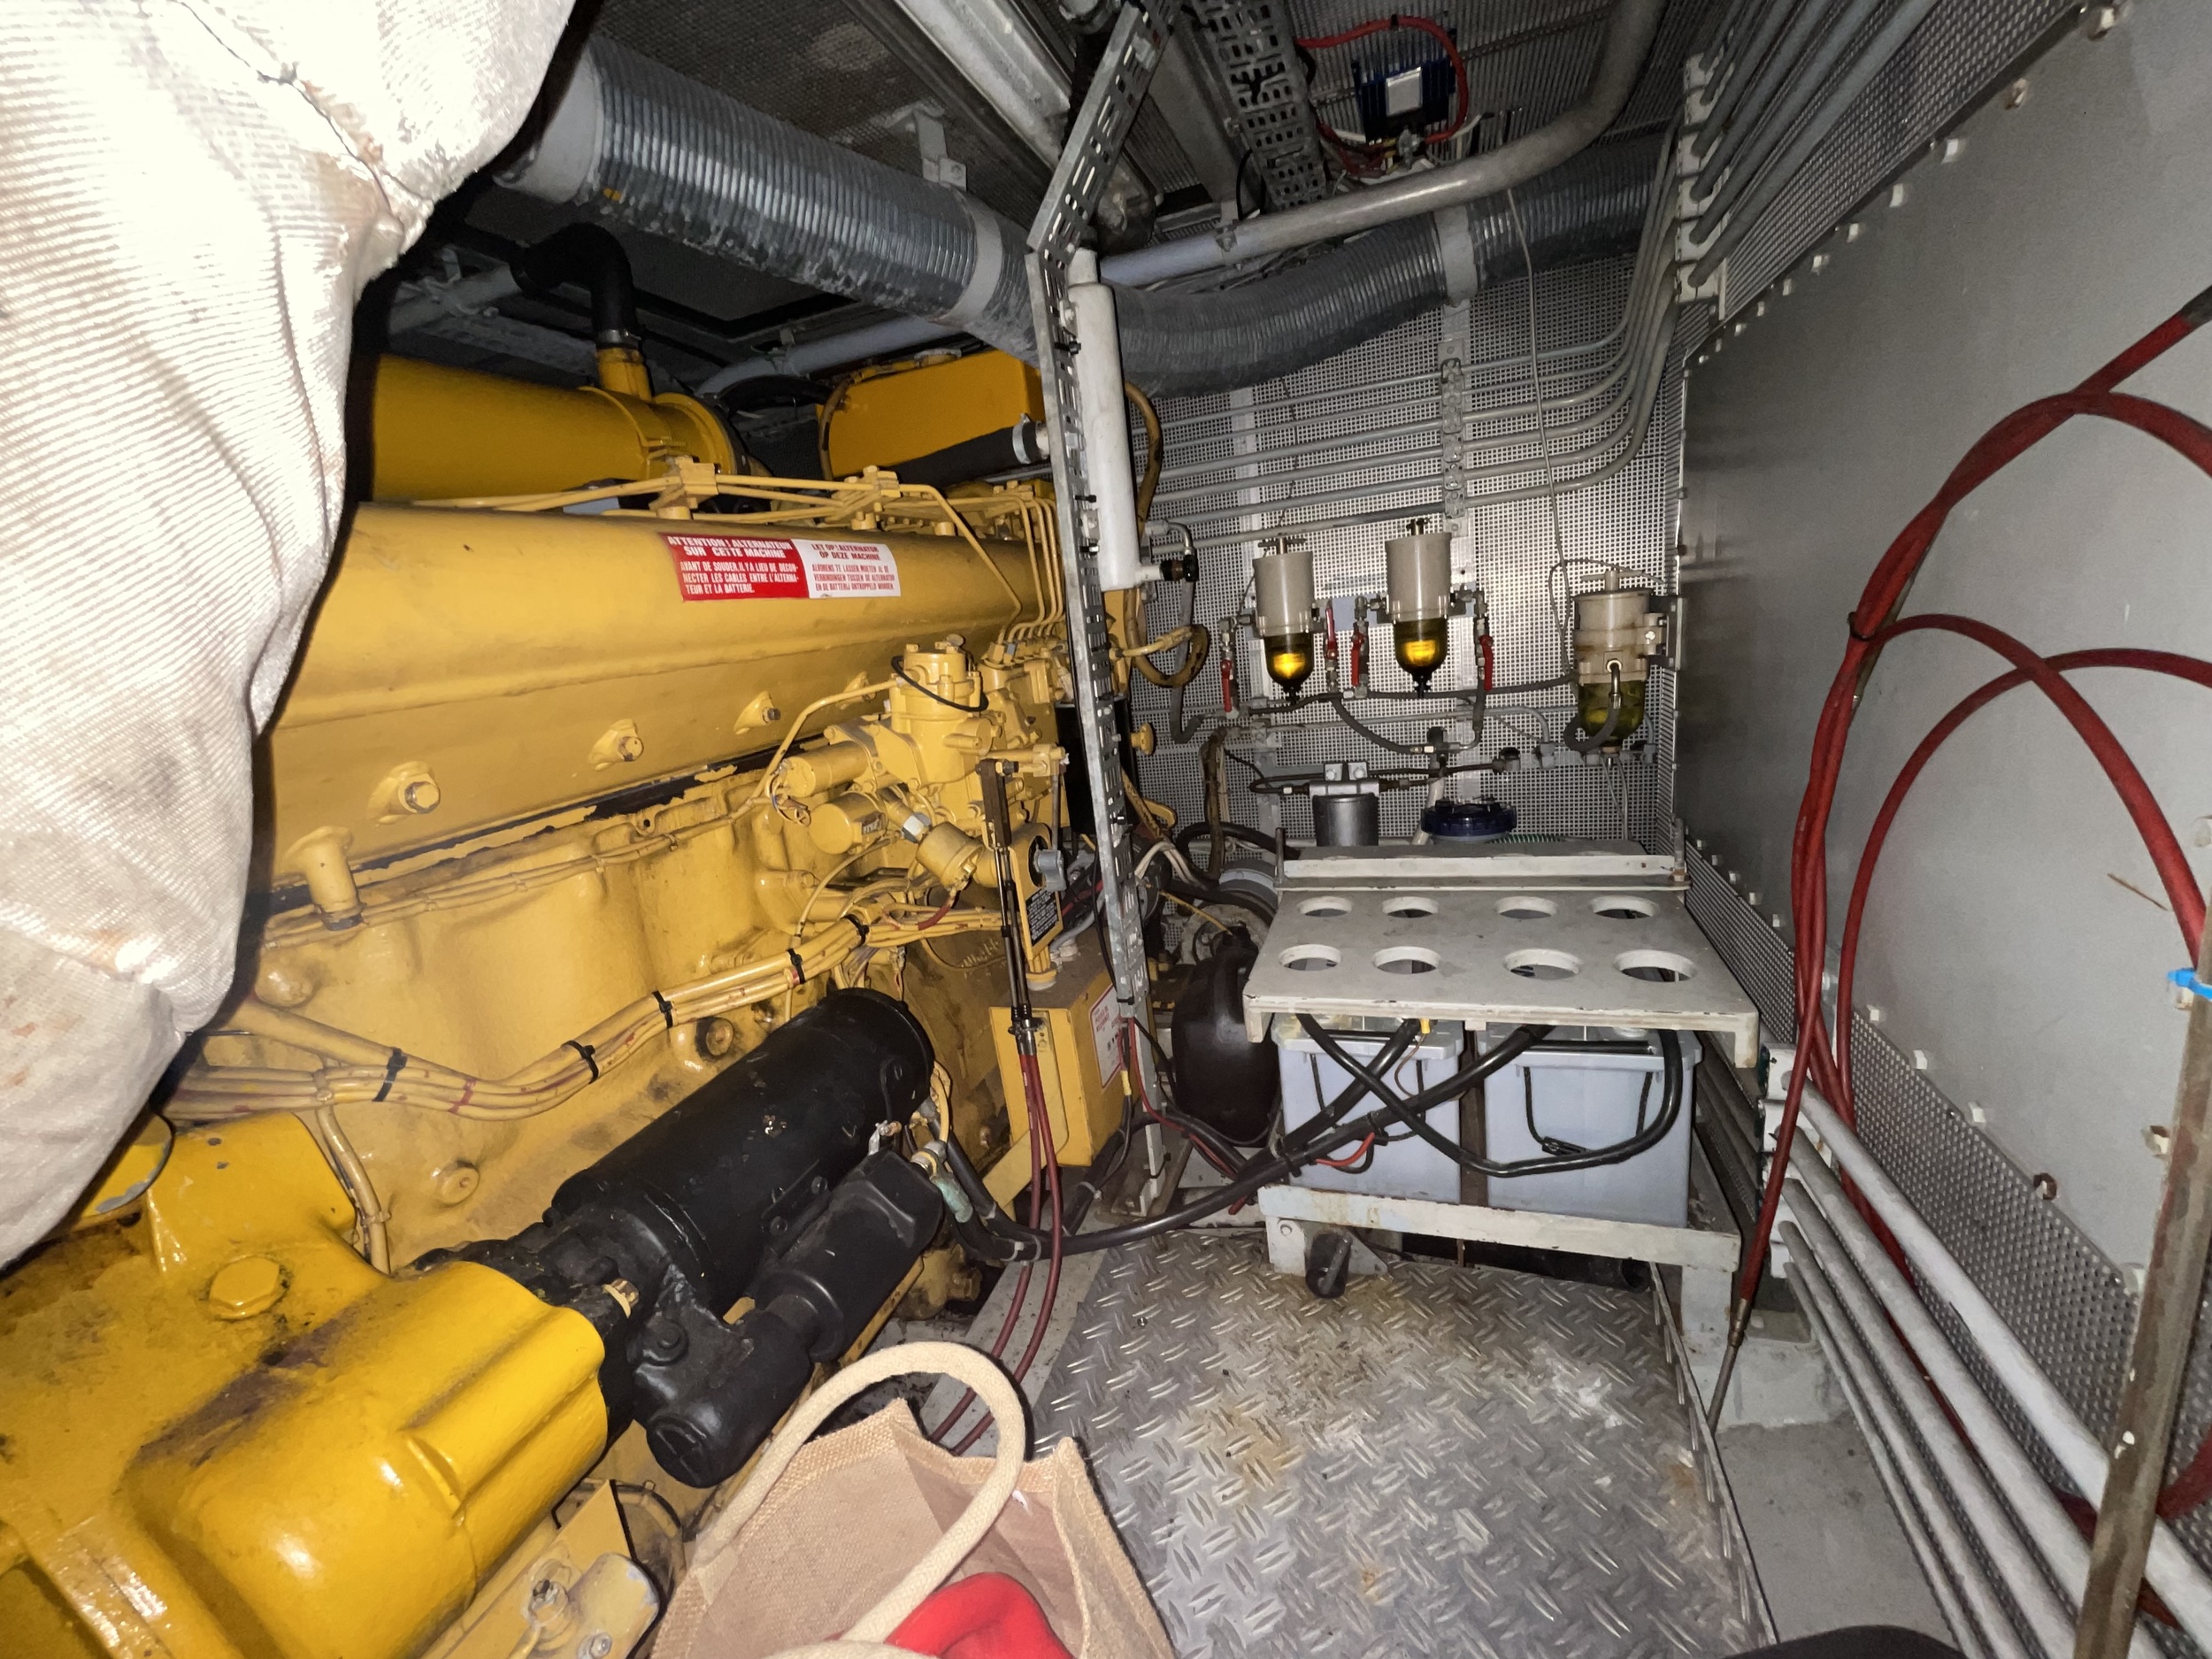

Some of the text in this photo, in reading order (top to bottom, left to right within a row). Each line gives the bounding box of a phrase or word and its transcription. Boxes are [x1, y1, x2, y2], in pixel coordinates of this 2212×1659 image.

[667, 536, 726, 547] ATTENTION
[732, 539, 793, 550] ALTERNATEUR
[684, 546, 787, 558] SUR CETTE MACHINE
[680, 561, 701, 572] AVANT
[702, 561, 713, 572] DE
[754, 562, 768, 572] LIEU
[768, 562, 777, 572] DE
[683, 572, 710, 584] NECTER
[710, 573, 723, 583] LES
[723, 572, 747, 583] CABLES
[749, 573, 769, 583] ENTRE
[684, 583, 755, 595] TEUR ET LA BATTERIE.
